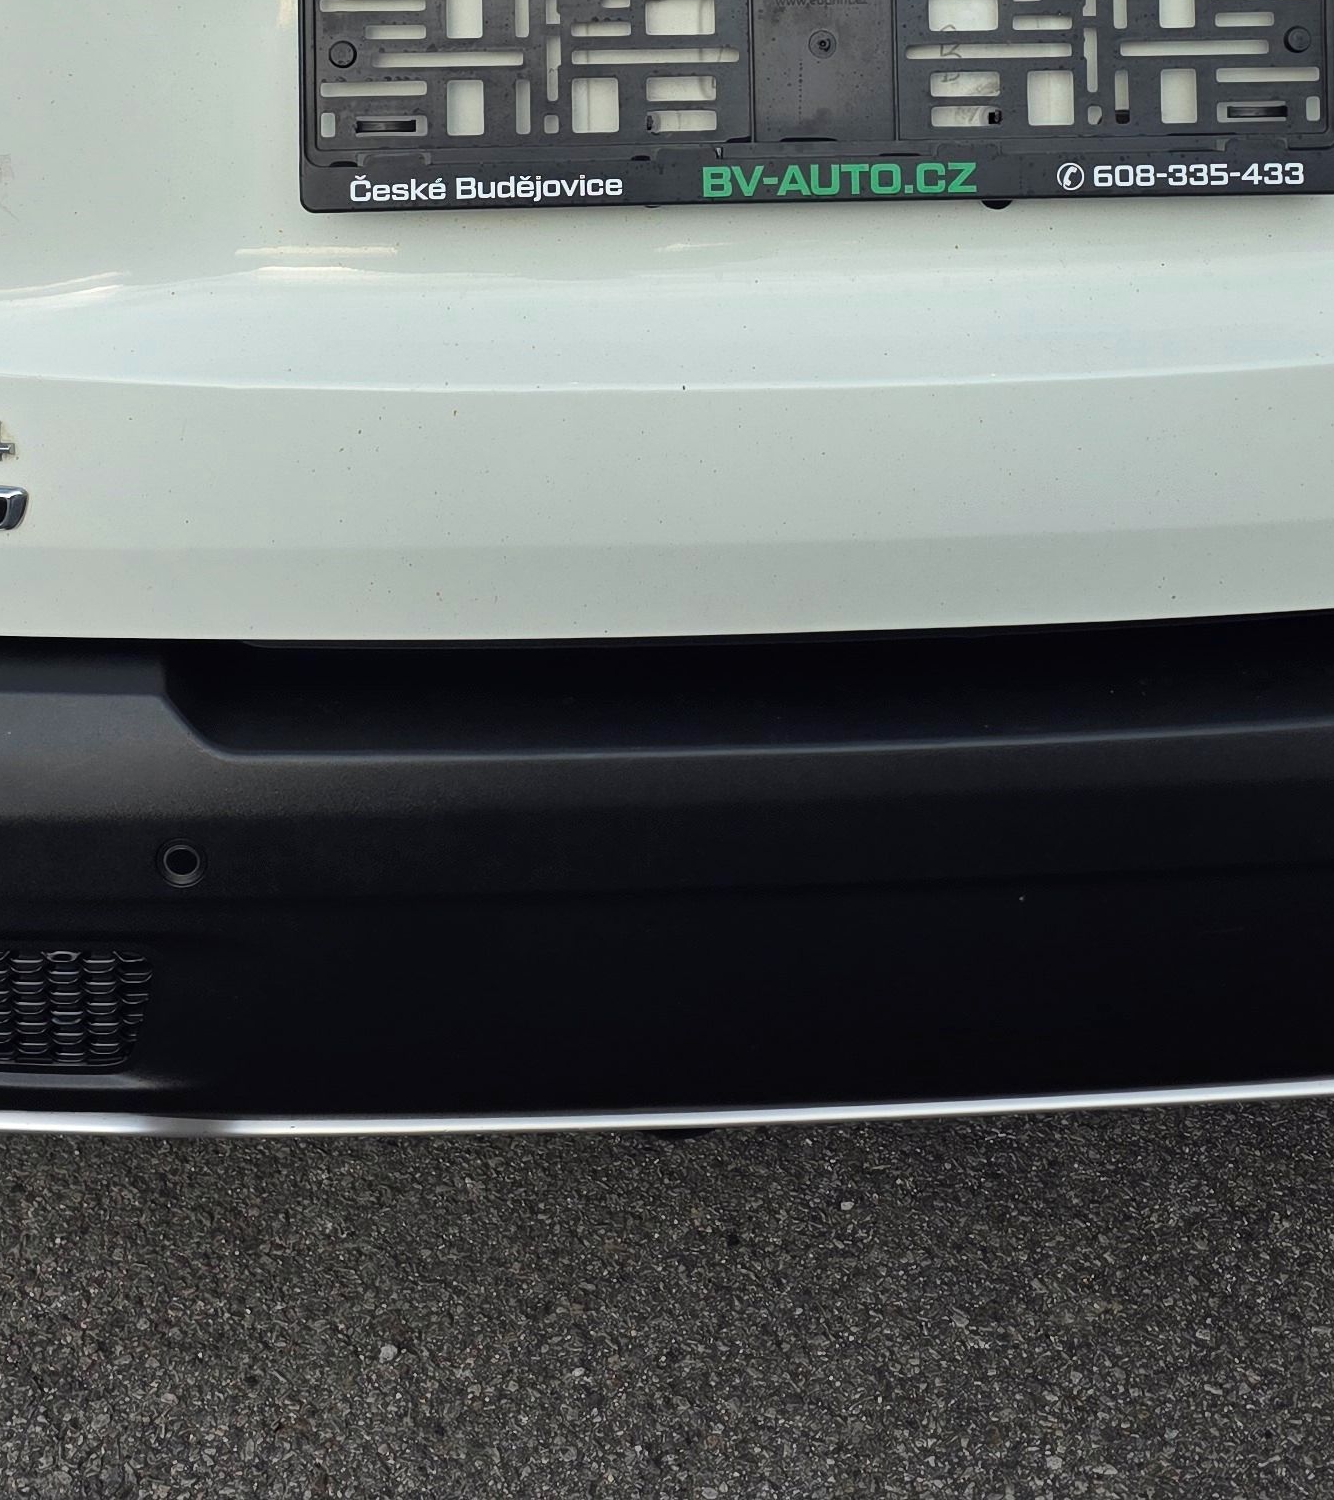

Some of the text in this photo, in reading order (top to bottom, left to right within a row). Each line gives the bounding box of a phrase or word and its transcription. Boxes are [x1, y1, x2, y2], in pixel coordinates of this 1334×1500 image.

[349, 174, 624, 202] České Budějovice
[702, 161, 978, 198] BV-AUTO.CZ
[1093, 162, 1305, 188] 608-335-433
